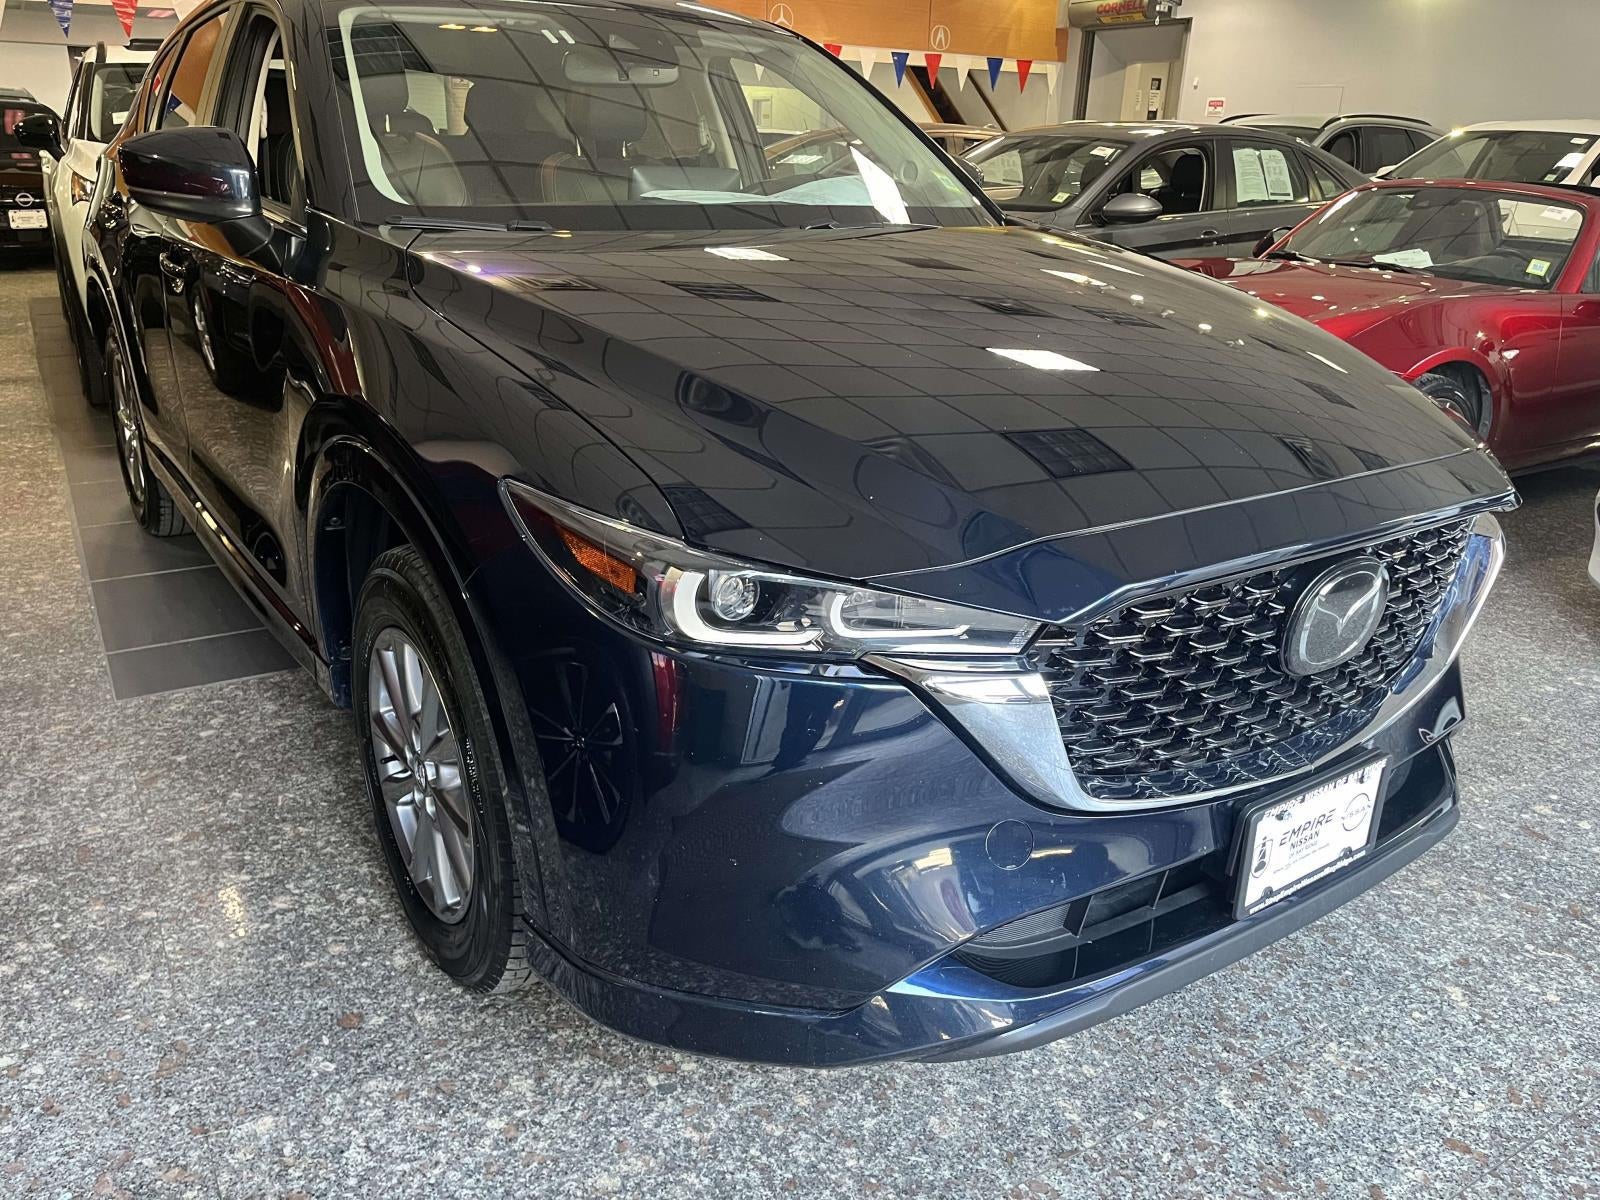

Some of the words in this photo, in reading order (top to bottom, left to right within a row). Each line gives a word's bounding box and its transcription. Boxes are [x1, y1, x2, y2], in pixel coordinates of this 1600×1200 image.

[1097, 1, 1145, 14] CORNELL
[1279, 808, 1336, 846] EMPIRE
[1290, 830, 1319, 850] NISSAN
